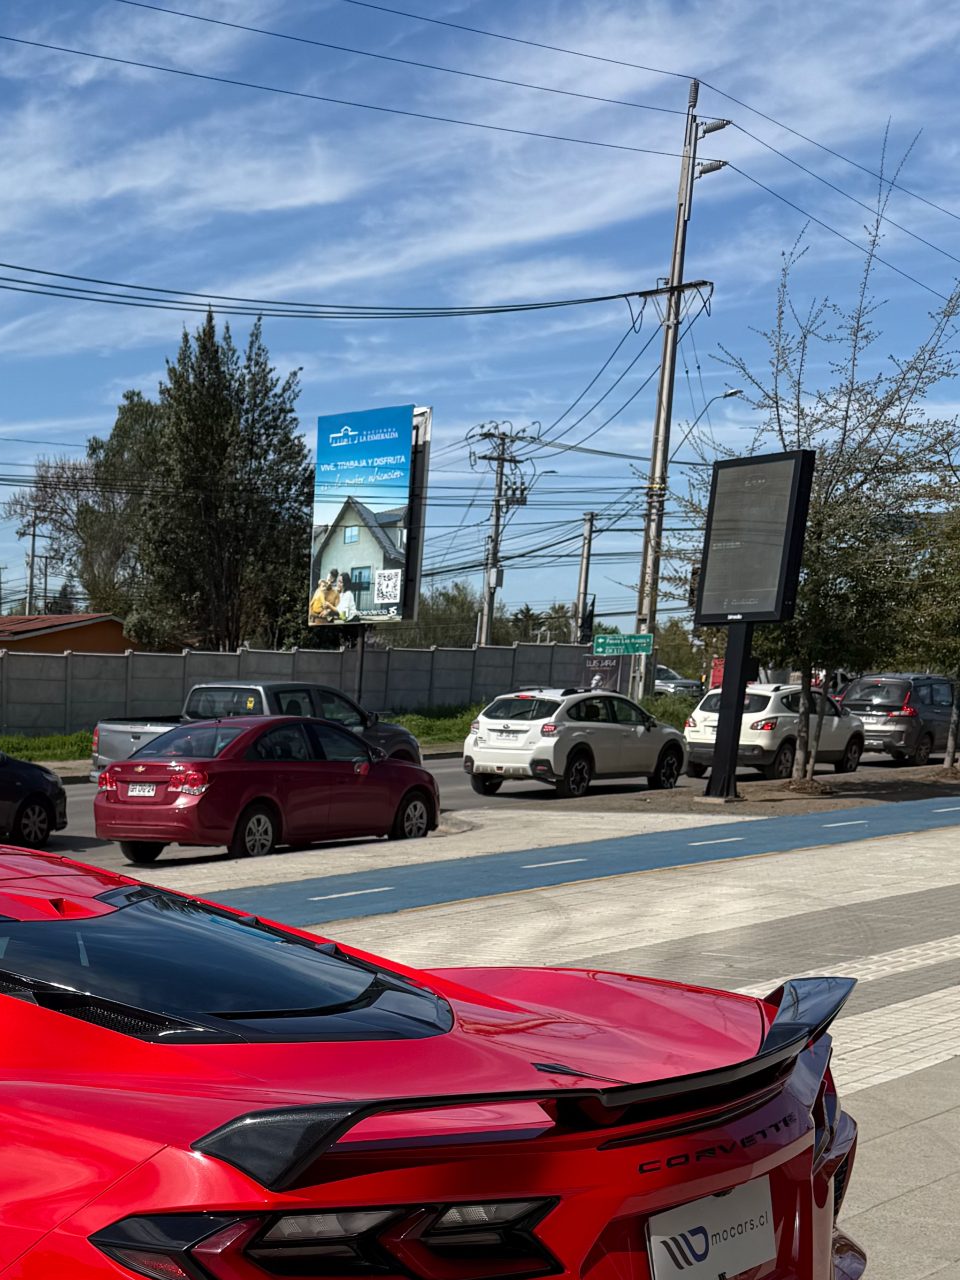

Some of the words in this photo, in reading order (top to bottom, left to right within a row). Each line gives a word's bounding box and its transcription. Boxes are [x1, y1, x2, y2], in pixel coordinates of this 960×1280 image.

[337, 458, 367, 470] TRABAJA
[373, 455, 406, 466] DISFRUTA
[638, 1111, 797, 1174] CORVETTE
[711, 1212, 769, 1246] mocars.cl
